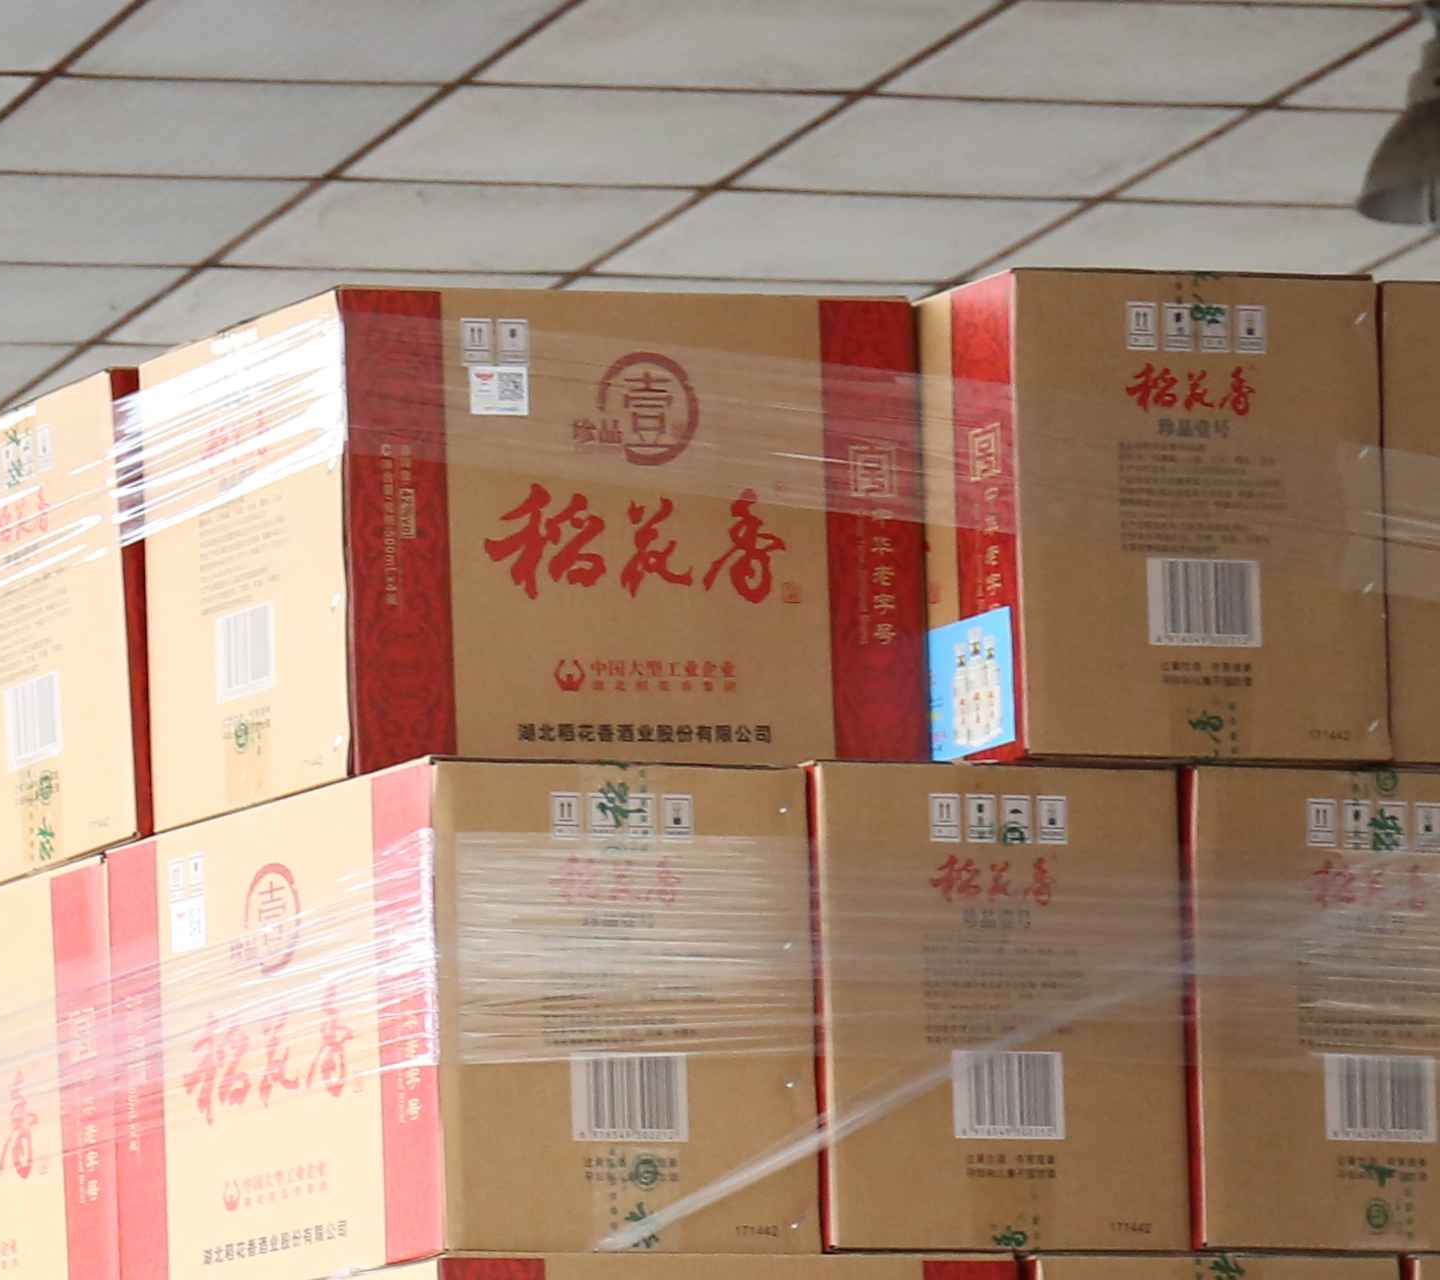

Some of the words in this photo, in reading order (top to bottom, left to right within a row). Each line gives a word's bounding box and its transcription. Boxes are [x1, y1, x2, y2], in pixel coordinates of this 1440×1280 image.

[1125, 361, 1250, 418] 稻花香
[485, 483, 787, 604] 稻花香
[518, 724, 772, 744] 湖北稻花香酒业股份有限公司
[184, 985, 353, 1126] 稻花香
